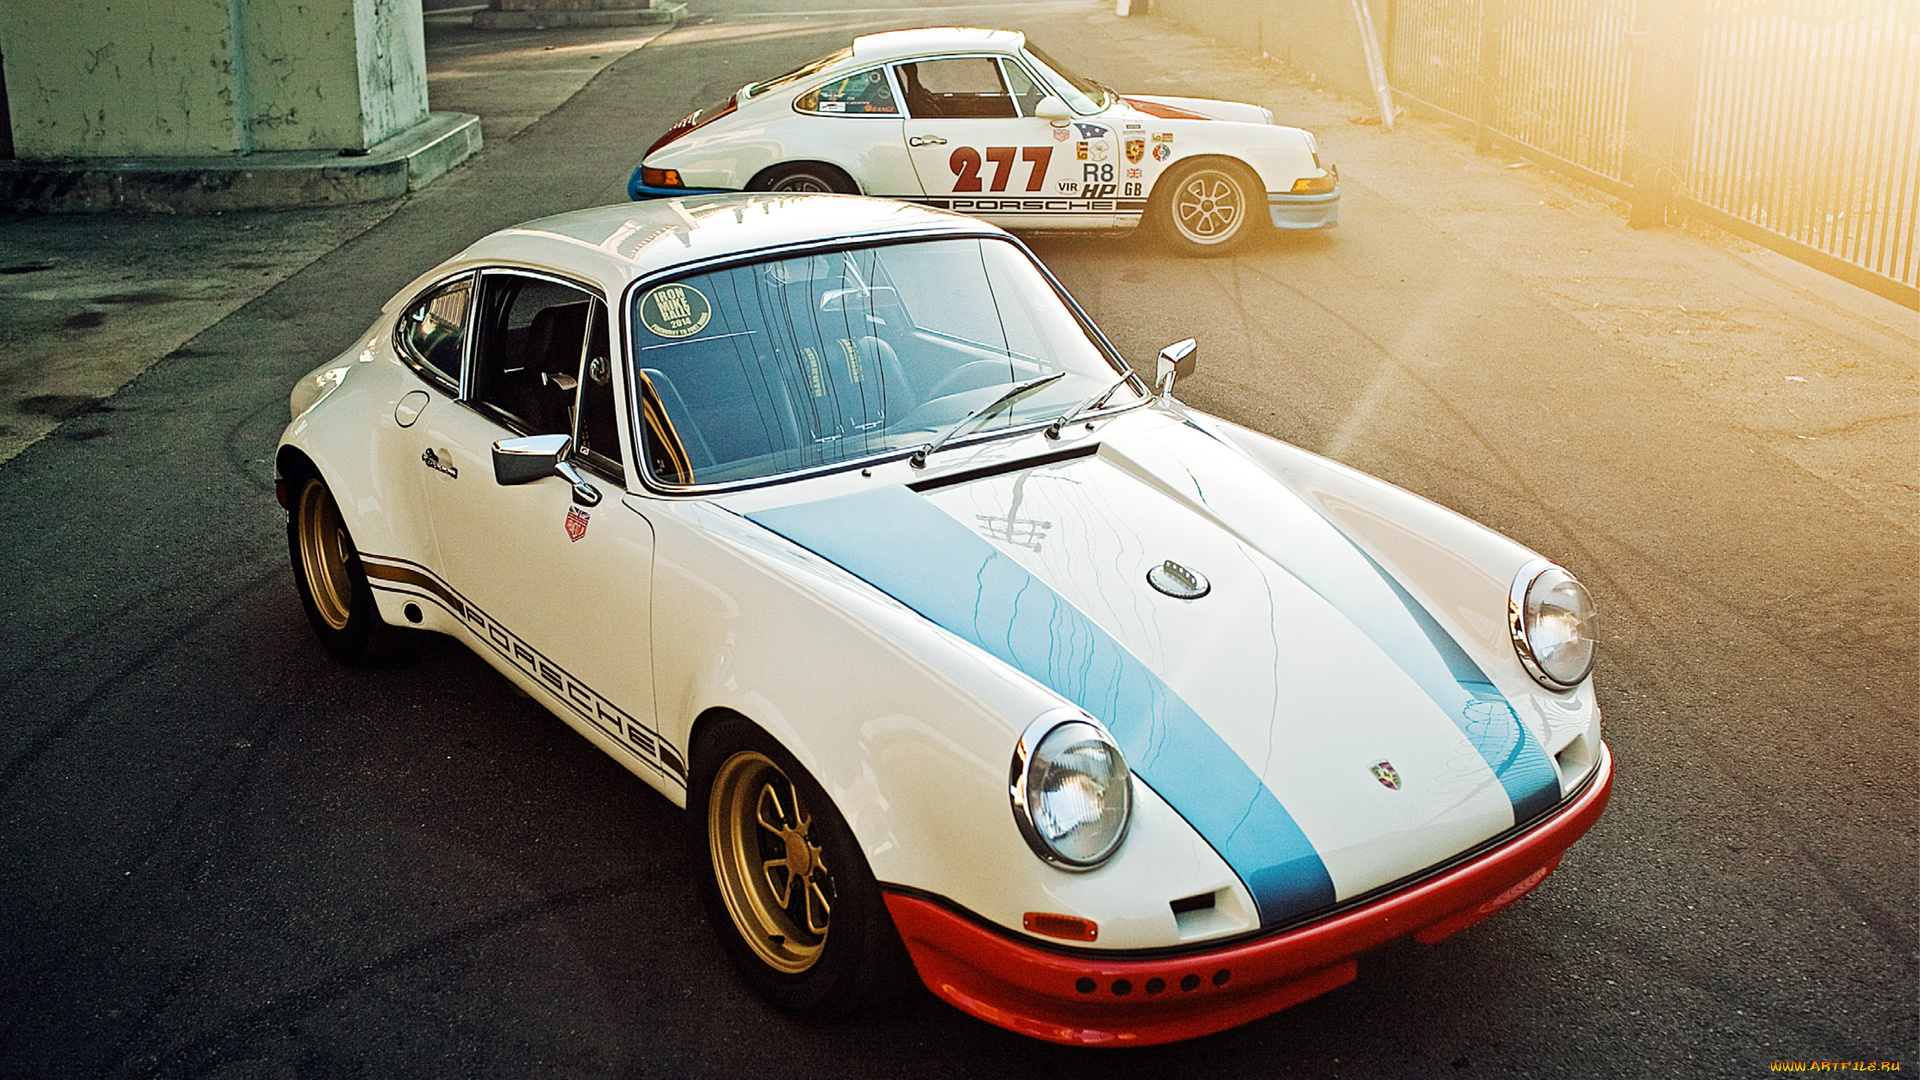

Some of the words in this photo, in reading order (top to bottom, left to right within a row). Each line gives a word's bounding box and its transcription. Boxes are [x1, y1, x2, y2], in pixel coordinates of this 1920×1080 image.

[949, 146, 1054, 193] 277
[1083, 163, 1113, 182] R8
[1058, 182, 1078, 192] VIR
[1080, 184, 1117, 198] HP
[1124, 182, 1142, 196] GB
[952, 200, 1113, 211] PORSCHE
[653, 288, 685, 303] IRON
[657, 297, 688, 313] MIKE
[661, 304, 692, 321] RALLY
[670, 317, 692, 329] 2014
[465, 605, 657, 758] PORSCHE
